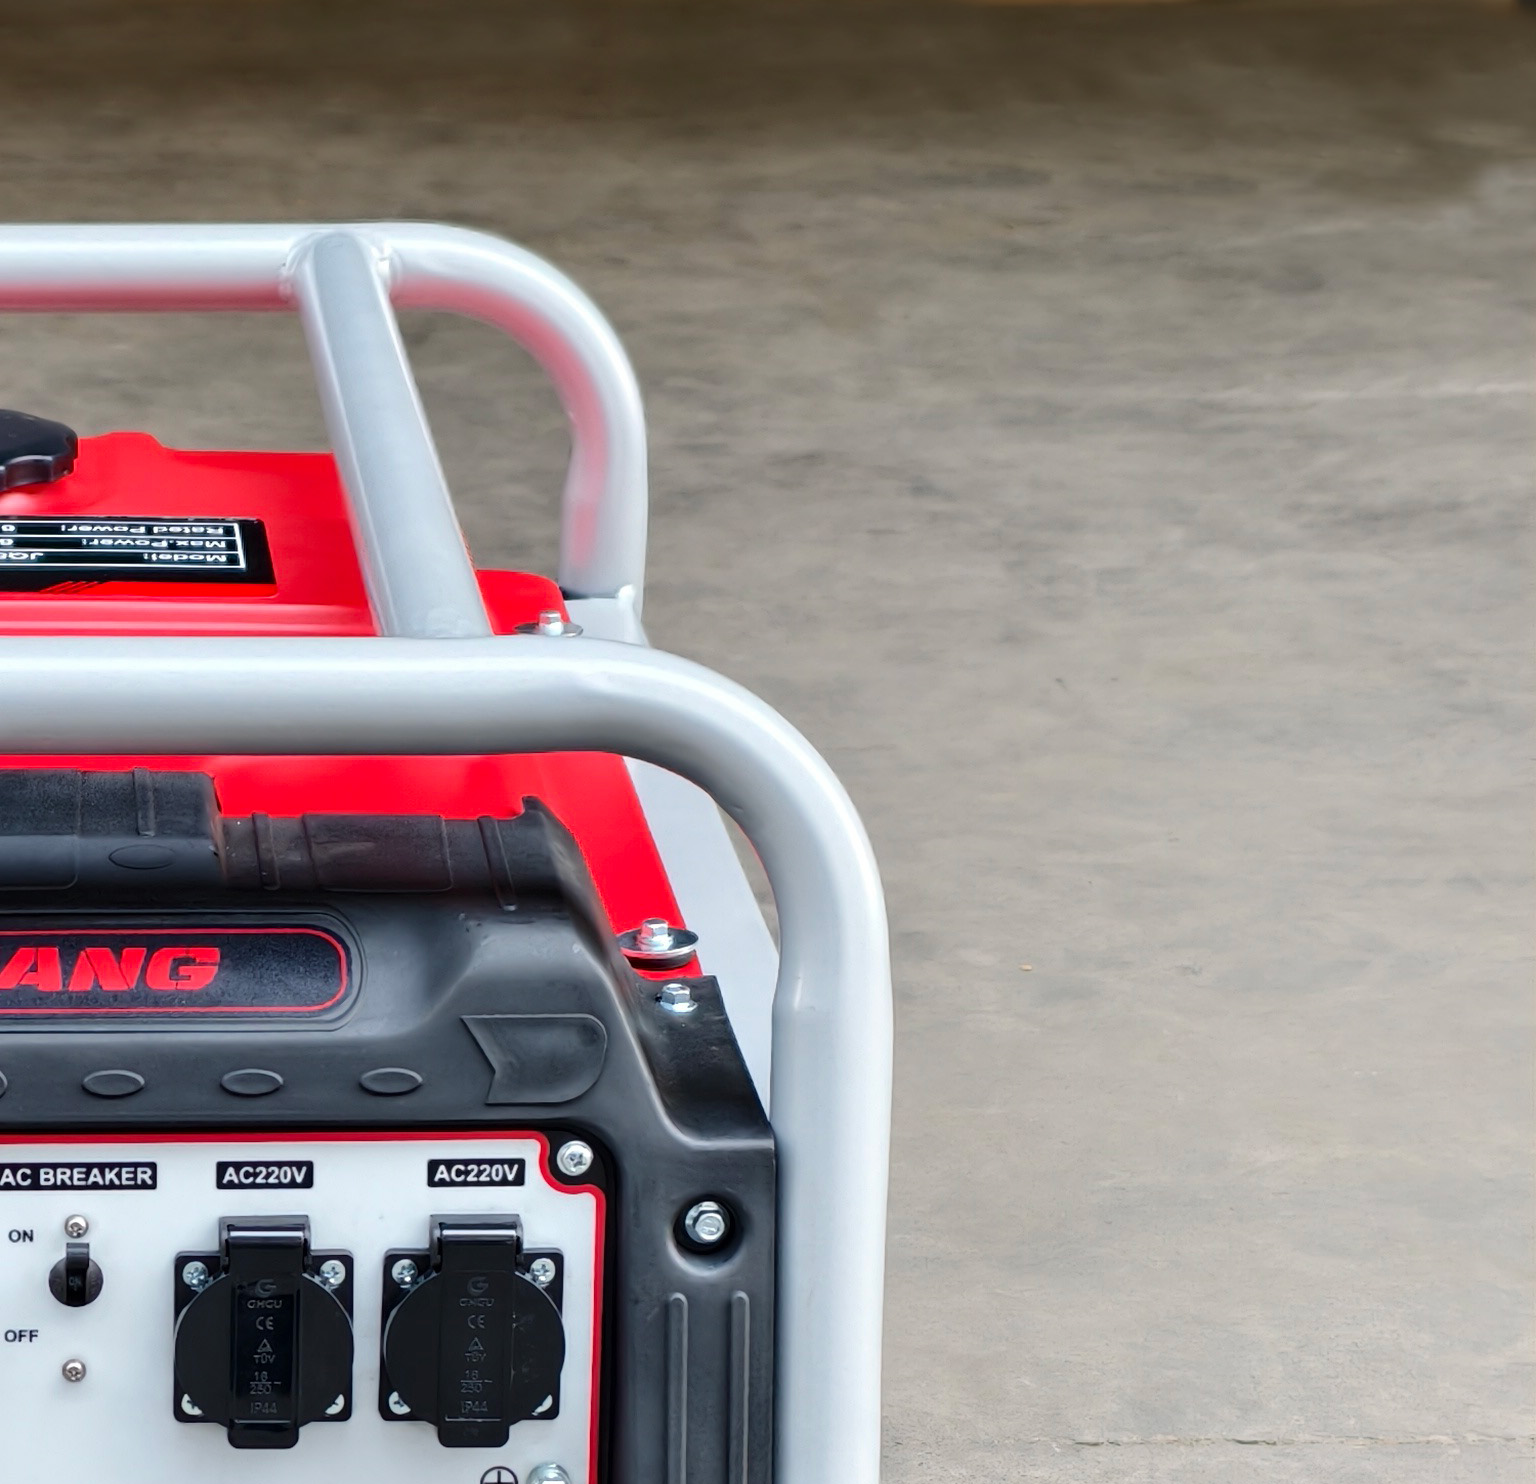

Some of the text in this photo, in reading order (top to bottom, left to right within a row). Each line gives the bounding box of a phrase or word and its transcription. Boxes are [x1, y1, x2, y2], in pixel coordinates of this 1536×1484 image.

[152, 525, 224, 535] Rated
[0, 1167, 153, 1187] AC BREAKER
[222, 1166, 307, 1184] AC220V
[433, 1164, 519, 1182] AC220V
[8, 1229, 34, 1243] ON
[4, 1329, 39, 1343] OFF
[250, 1401, 278, 1415] IP44
